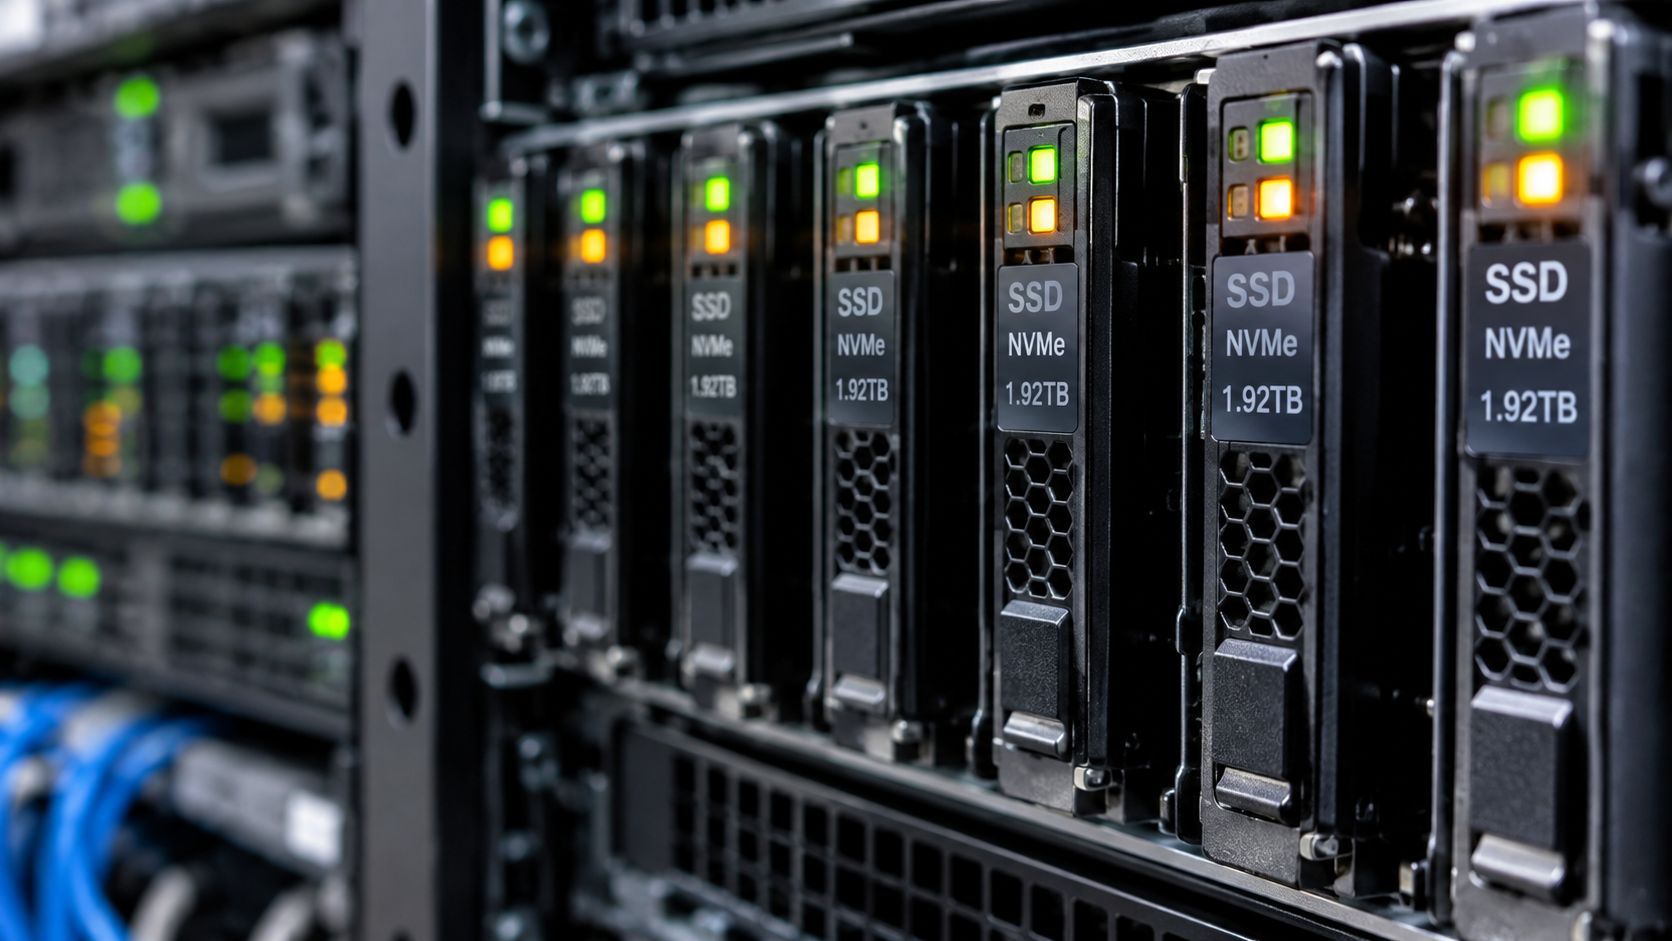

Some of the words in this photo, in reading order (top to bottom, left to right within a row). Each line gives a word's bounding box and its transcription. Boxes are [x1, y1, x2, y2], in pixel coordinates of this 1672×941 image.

[1008, 280, 1063, 314] SSD
[1226, 270, 1295, 309] SSD
[1485, 260, 1568, 305] SSD
[692, 293, 731, 322] SSD
[838, 287, 883, 317] SSD
[691, 335, 733, 357] NVMe
[837, 333, 885, 357] NVMe
[1008, 331, 1065, 357] NVMe
[1226, 328, 1298, 357] NVMe
[1485, 326, 1571, 360] NVMe
[690, 376, 736, 399] 1.92TB
[836, 378, 888, 402] 1.92TB
[1006, 381, 1069, 407] 1.92TB
[1222, 384, 1303, 415] 1.92TB
[1480, 390, 1578, 424] 1.92TB
